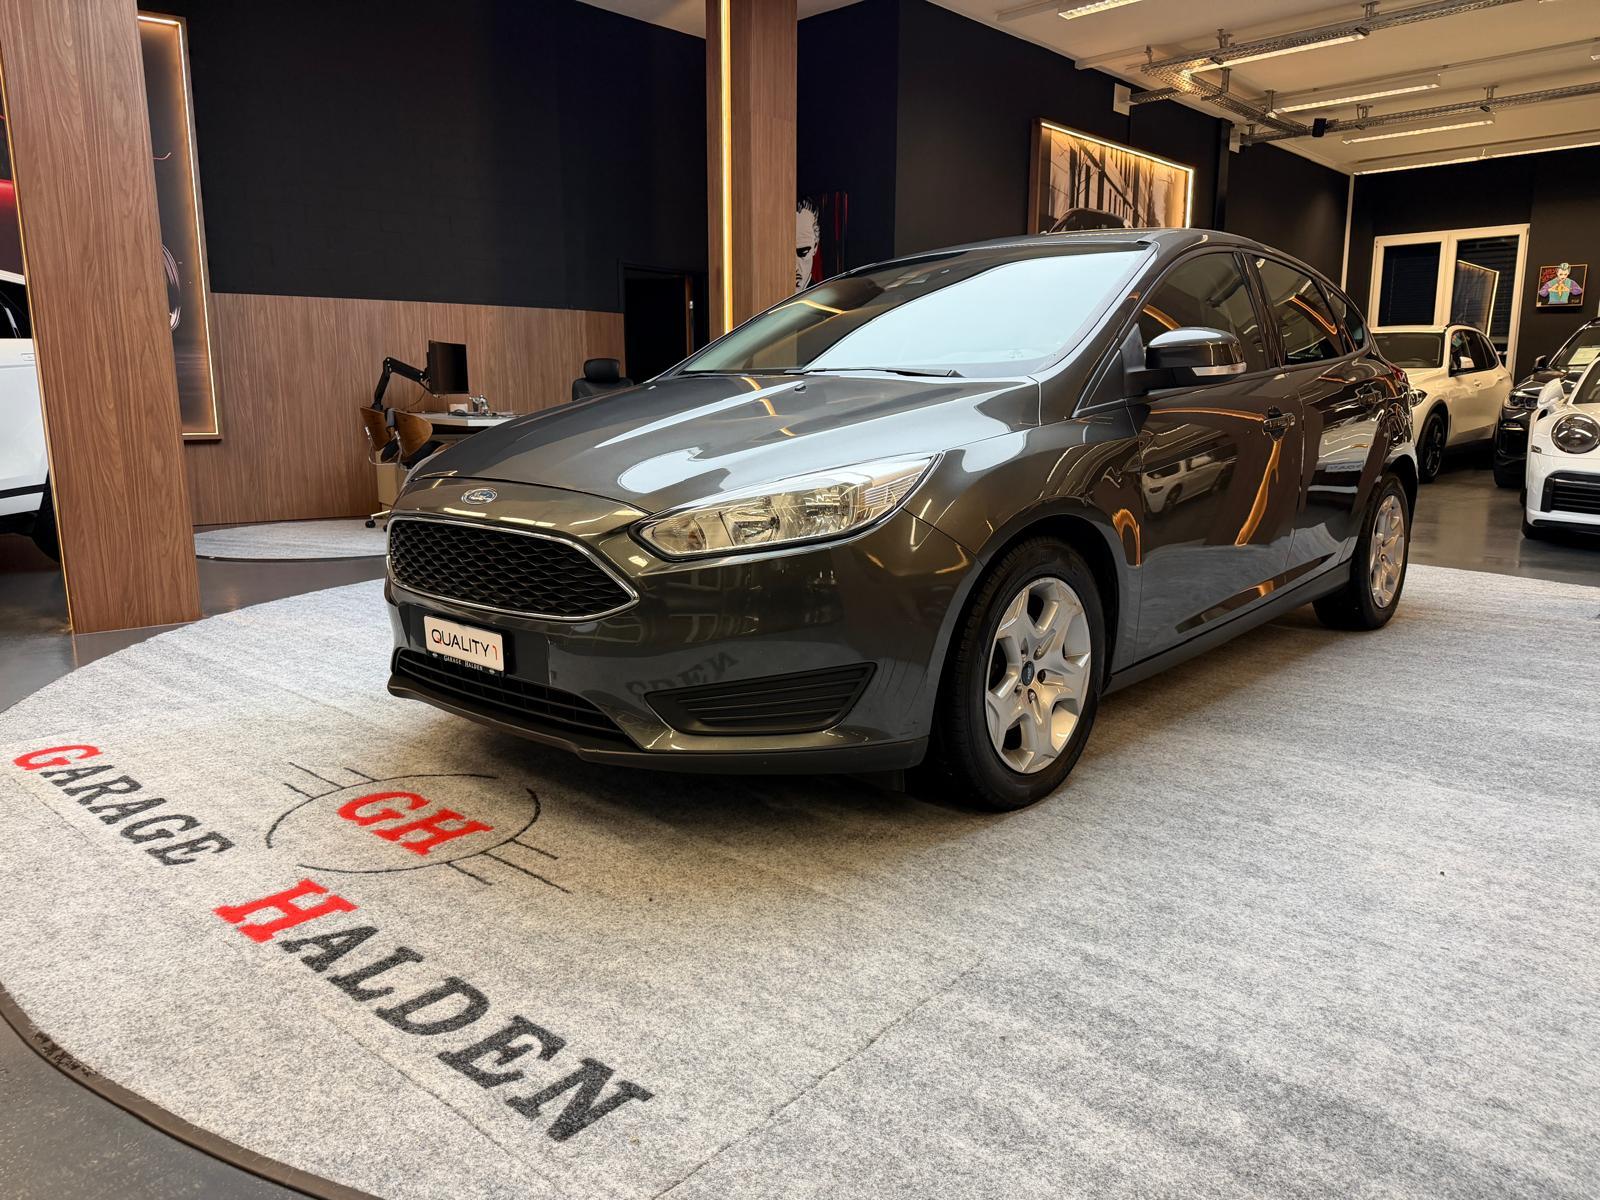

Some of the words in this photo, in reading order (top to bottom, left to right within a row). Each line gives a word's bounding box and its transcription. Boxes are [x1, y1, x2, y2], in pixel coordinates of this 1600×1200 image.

[431, 628, 489, 657] QUALITY
[14, 744, 235, 866] GARAGE
[336, 790, 494, 855] GH
[212, 878, 654, 1141] HALDEN
